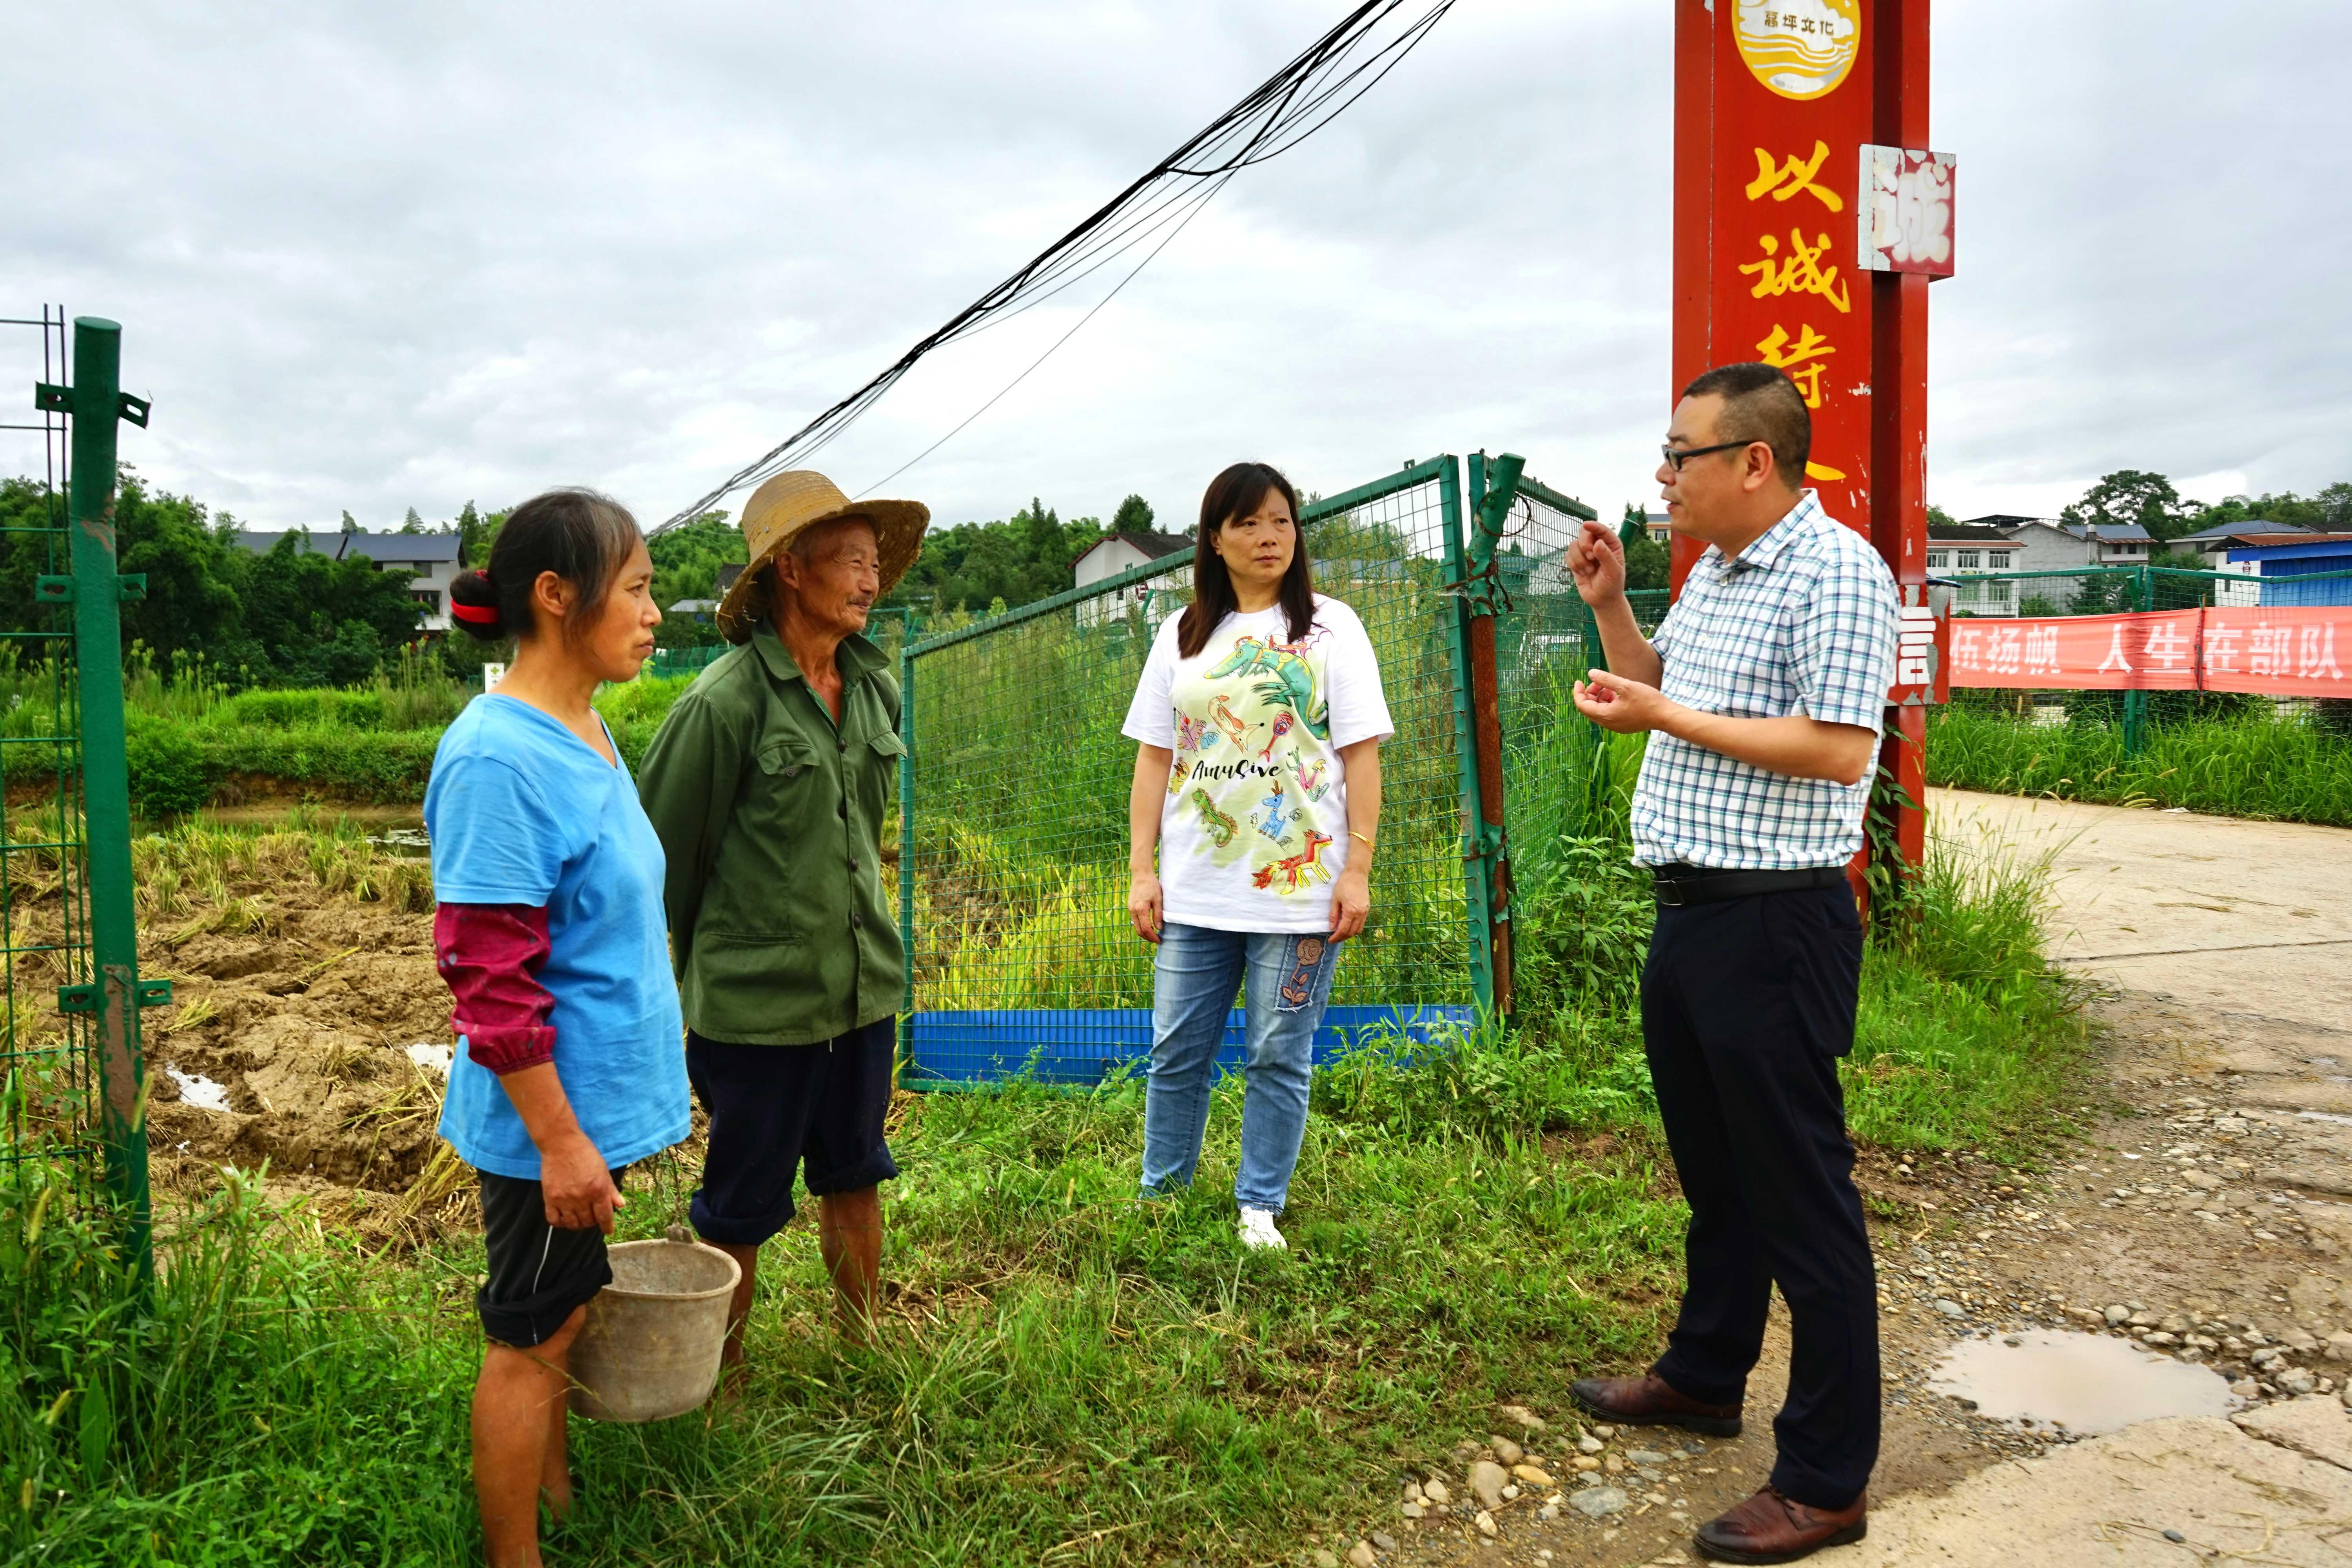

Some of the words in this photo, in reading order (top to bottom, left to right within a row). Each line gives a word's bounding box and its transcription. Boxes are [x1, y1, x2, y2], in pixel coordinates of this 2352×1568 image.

[2096, 621, 2344, 681] 人生在部队
